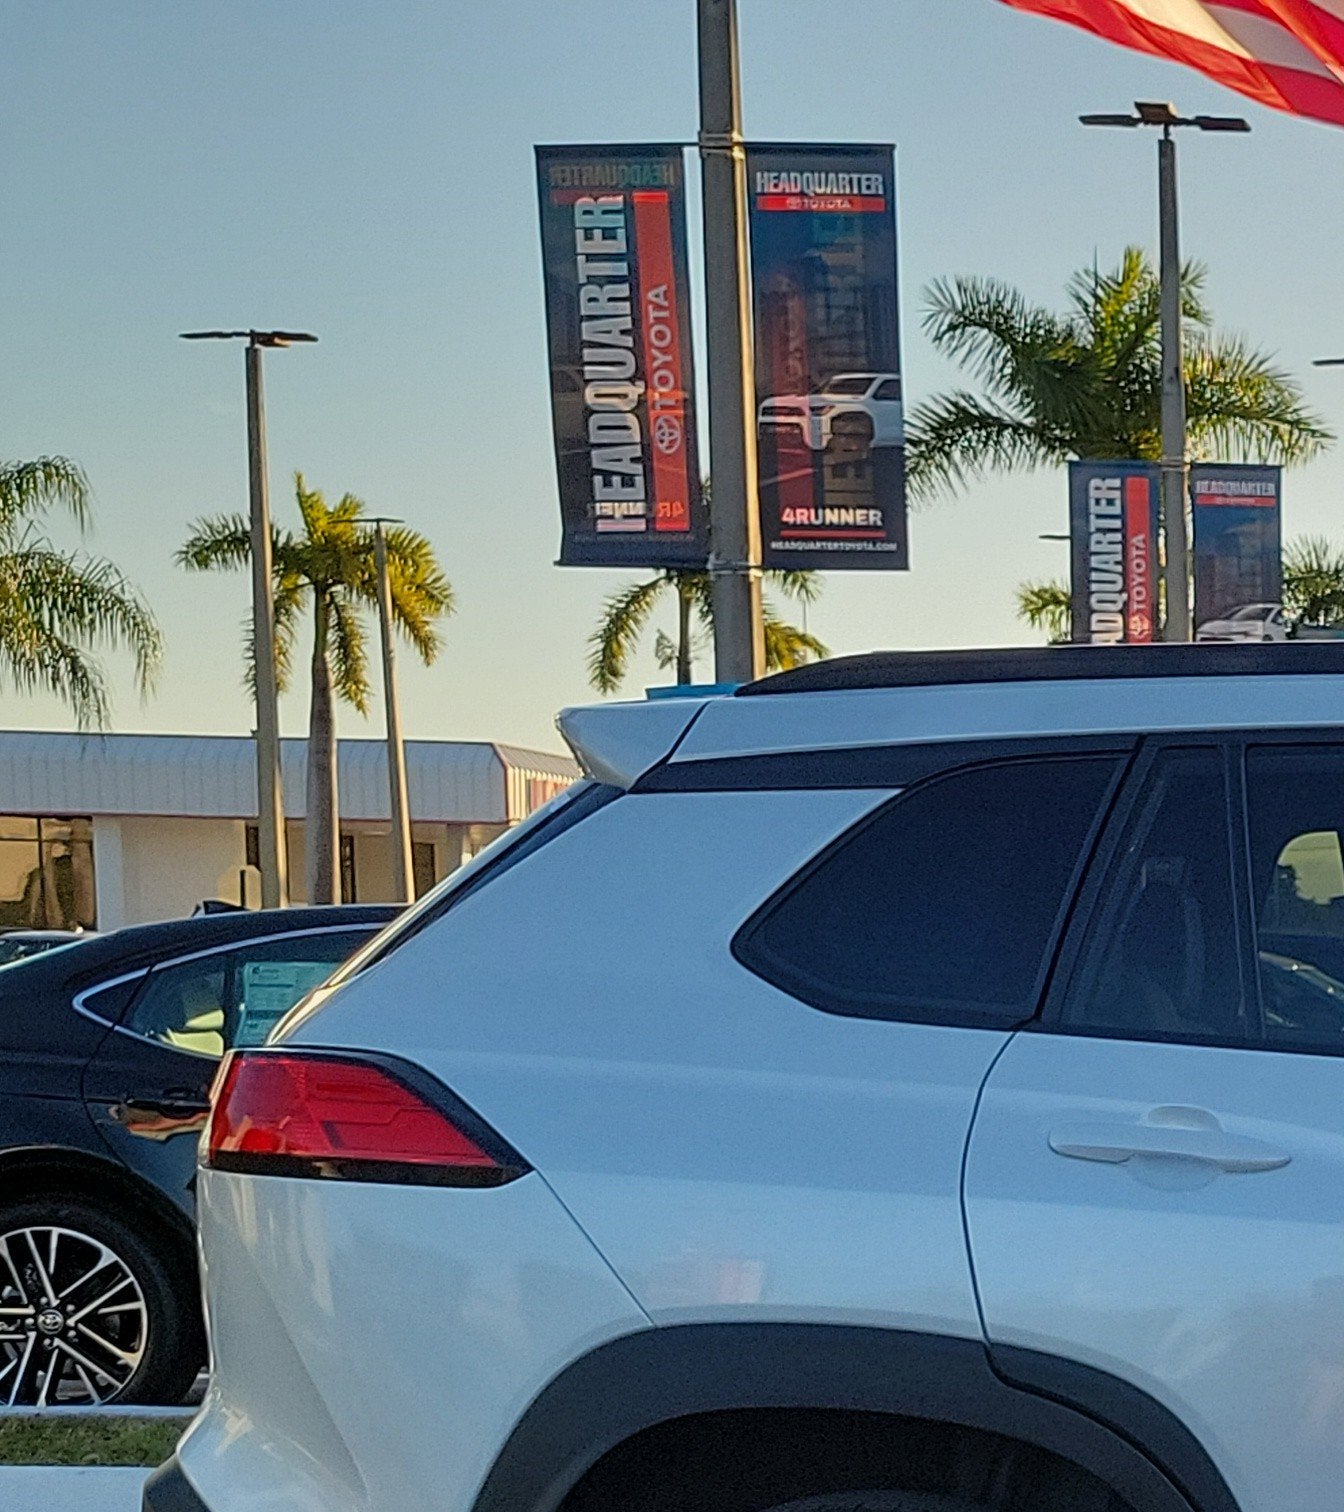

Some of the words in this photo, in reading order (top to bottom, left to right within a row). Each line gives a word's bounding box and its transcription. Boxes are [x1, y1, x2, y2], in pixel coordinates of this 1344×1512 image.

[756, 171, 884, 195] HEADQUARTER
[804, 199, 851, 209] TOYOTA
[574, 194, 647, 532] HEADQUARTER
[647, 284, 673, 410] TOYOTA
[781, 507, 884, 527] 4RUNNER
[1089, 477, 1128, 643] DQUARTER
[1131, 534, 1147, 610] TOYOTA
